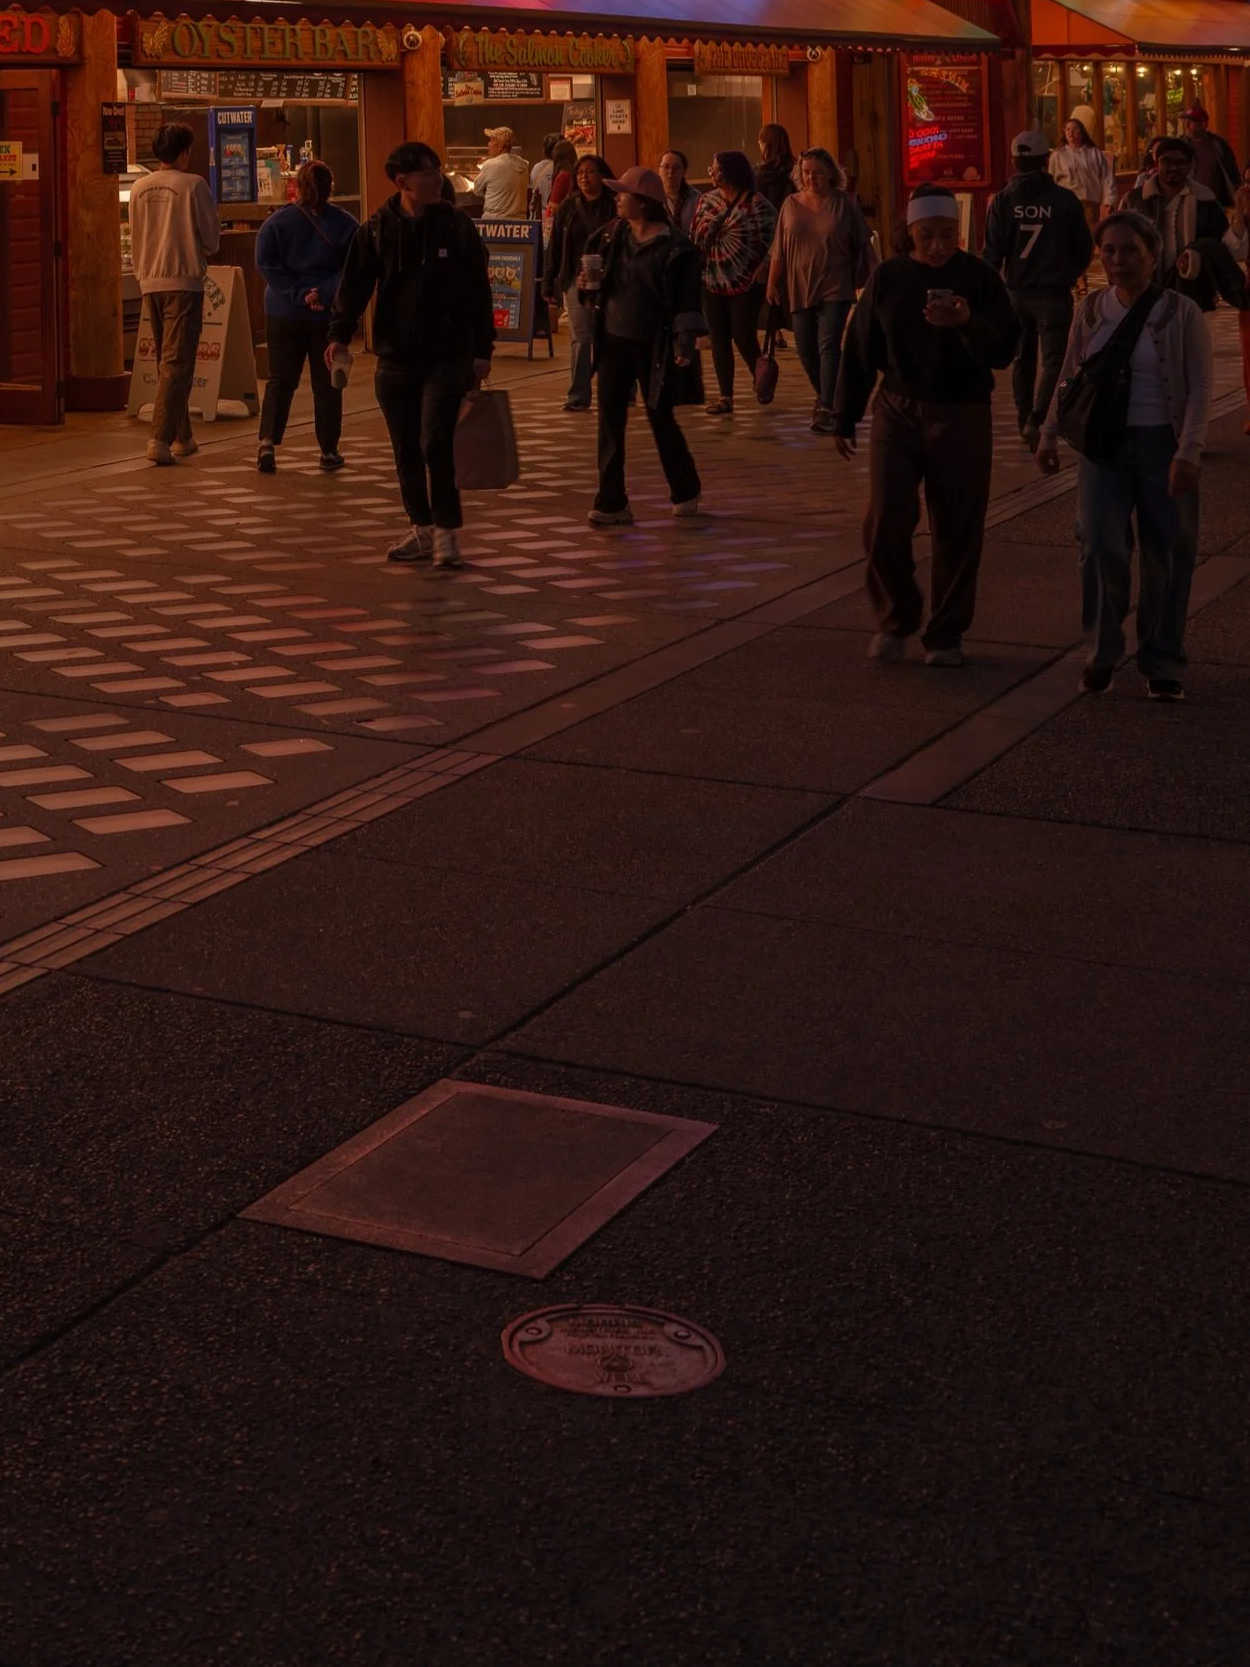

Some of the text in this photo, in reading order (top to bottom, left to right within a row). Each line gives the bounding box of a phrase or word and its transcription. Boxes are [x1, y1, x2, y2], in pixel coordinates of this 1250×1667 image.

[173, 21, 379, 60] OYSTER BAR
[474, 36, 502, 66] The
[505, 37, 569, 67] Salmon
[216, 110, 253, 126] CUTWATER
[1013, 205, 1053, 219] SON
[475, 223, 530, 239] TWATER
[1019, 223, 1044, 259] 7
